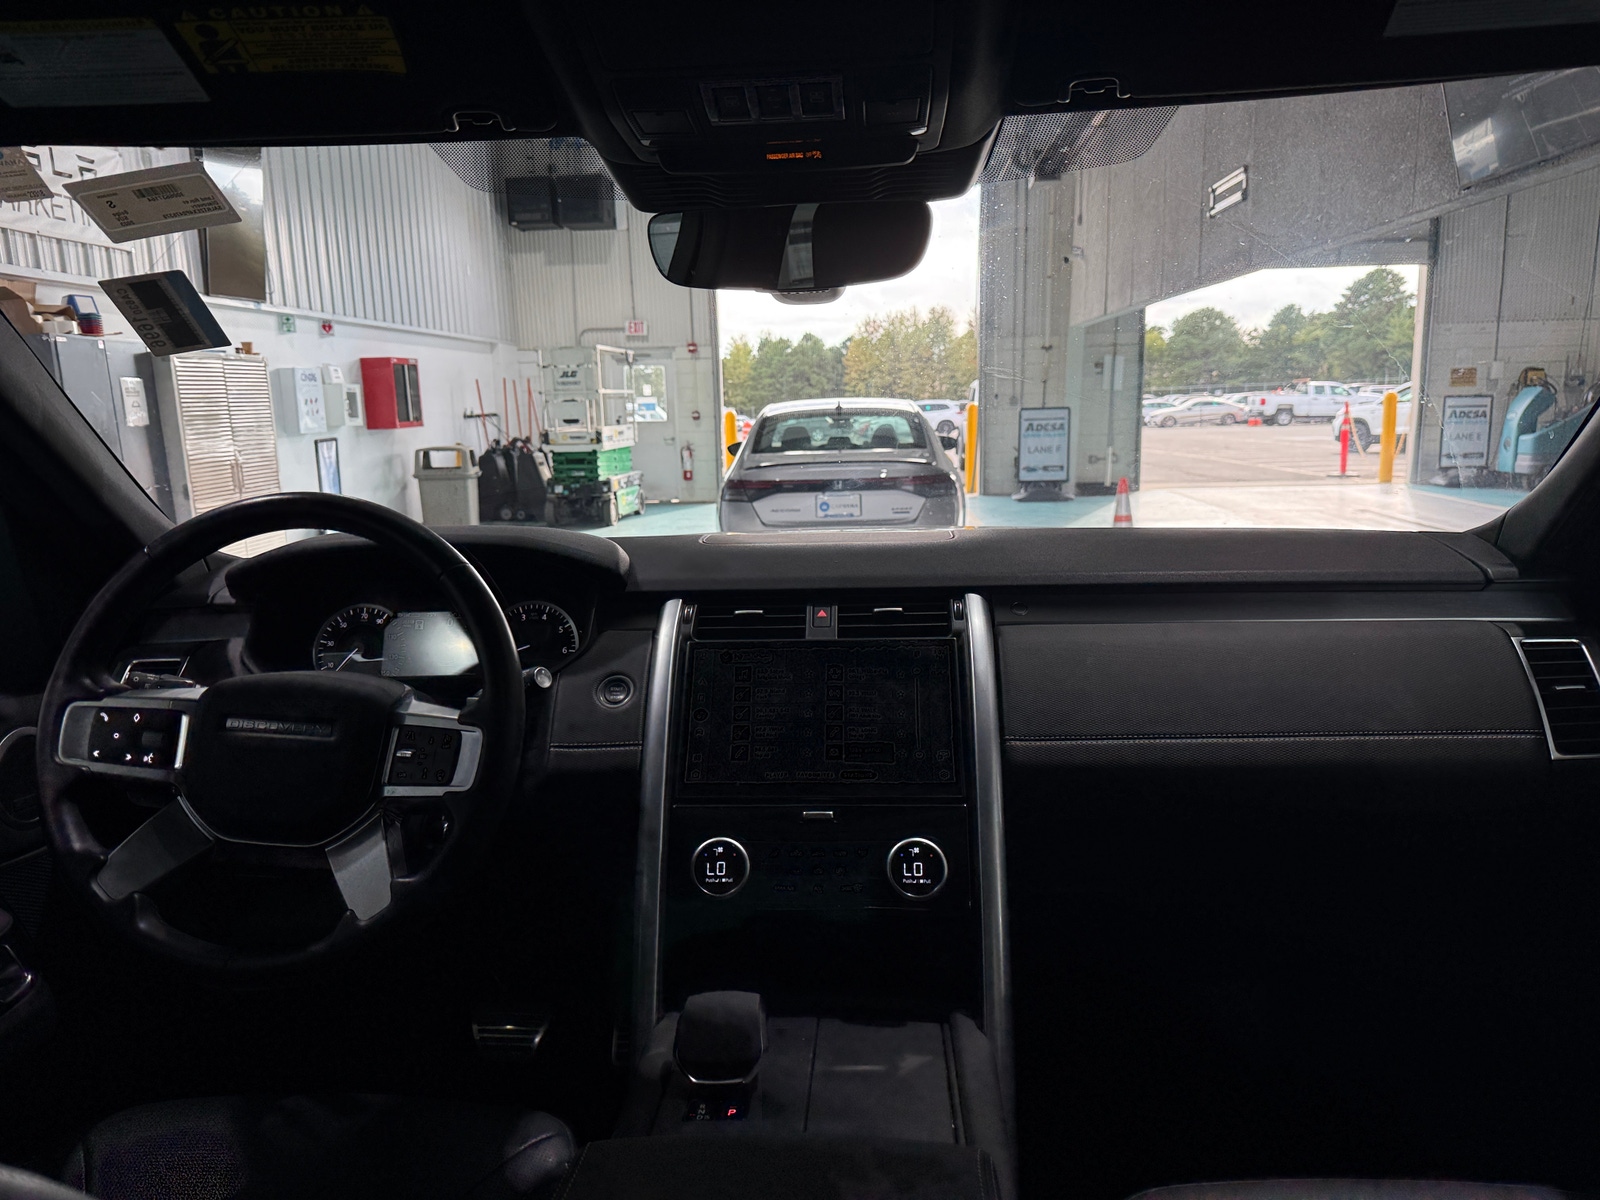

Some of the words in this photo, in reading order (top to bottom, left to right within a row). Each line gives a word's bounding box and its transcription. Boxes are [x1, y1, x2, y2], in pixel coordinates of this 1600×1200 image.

[208, 4, 344, 20] CAUTION
[628, 321, 645, 335] EXIT
[559, 370, 578, 379] JLG
[1449, 432, 1474, 441] LANE
[1476, 432, 1482, 441] E
[1027, 445, 1053, 455] LANE
[1056, 444, 1062, 453] F
[558, 626, 564, 634] 5
[562, 646, 568, 654] 6
[706, 861, 726, 876] LO
[903, 862, 923, 877] LO
